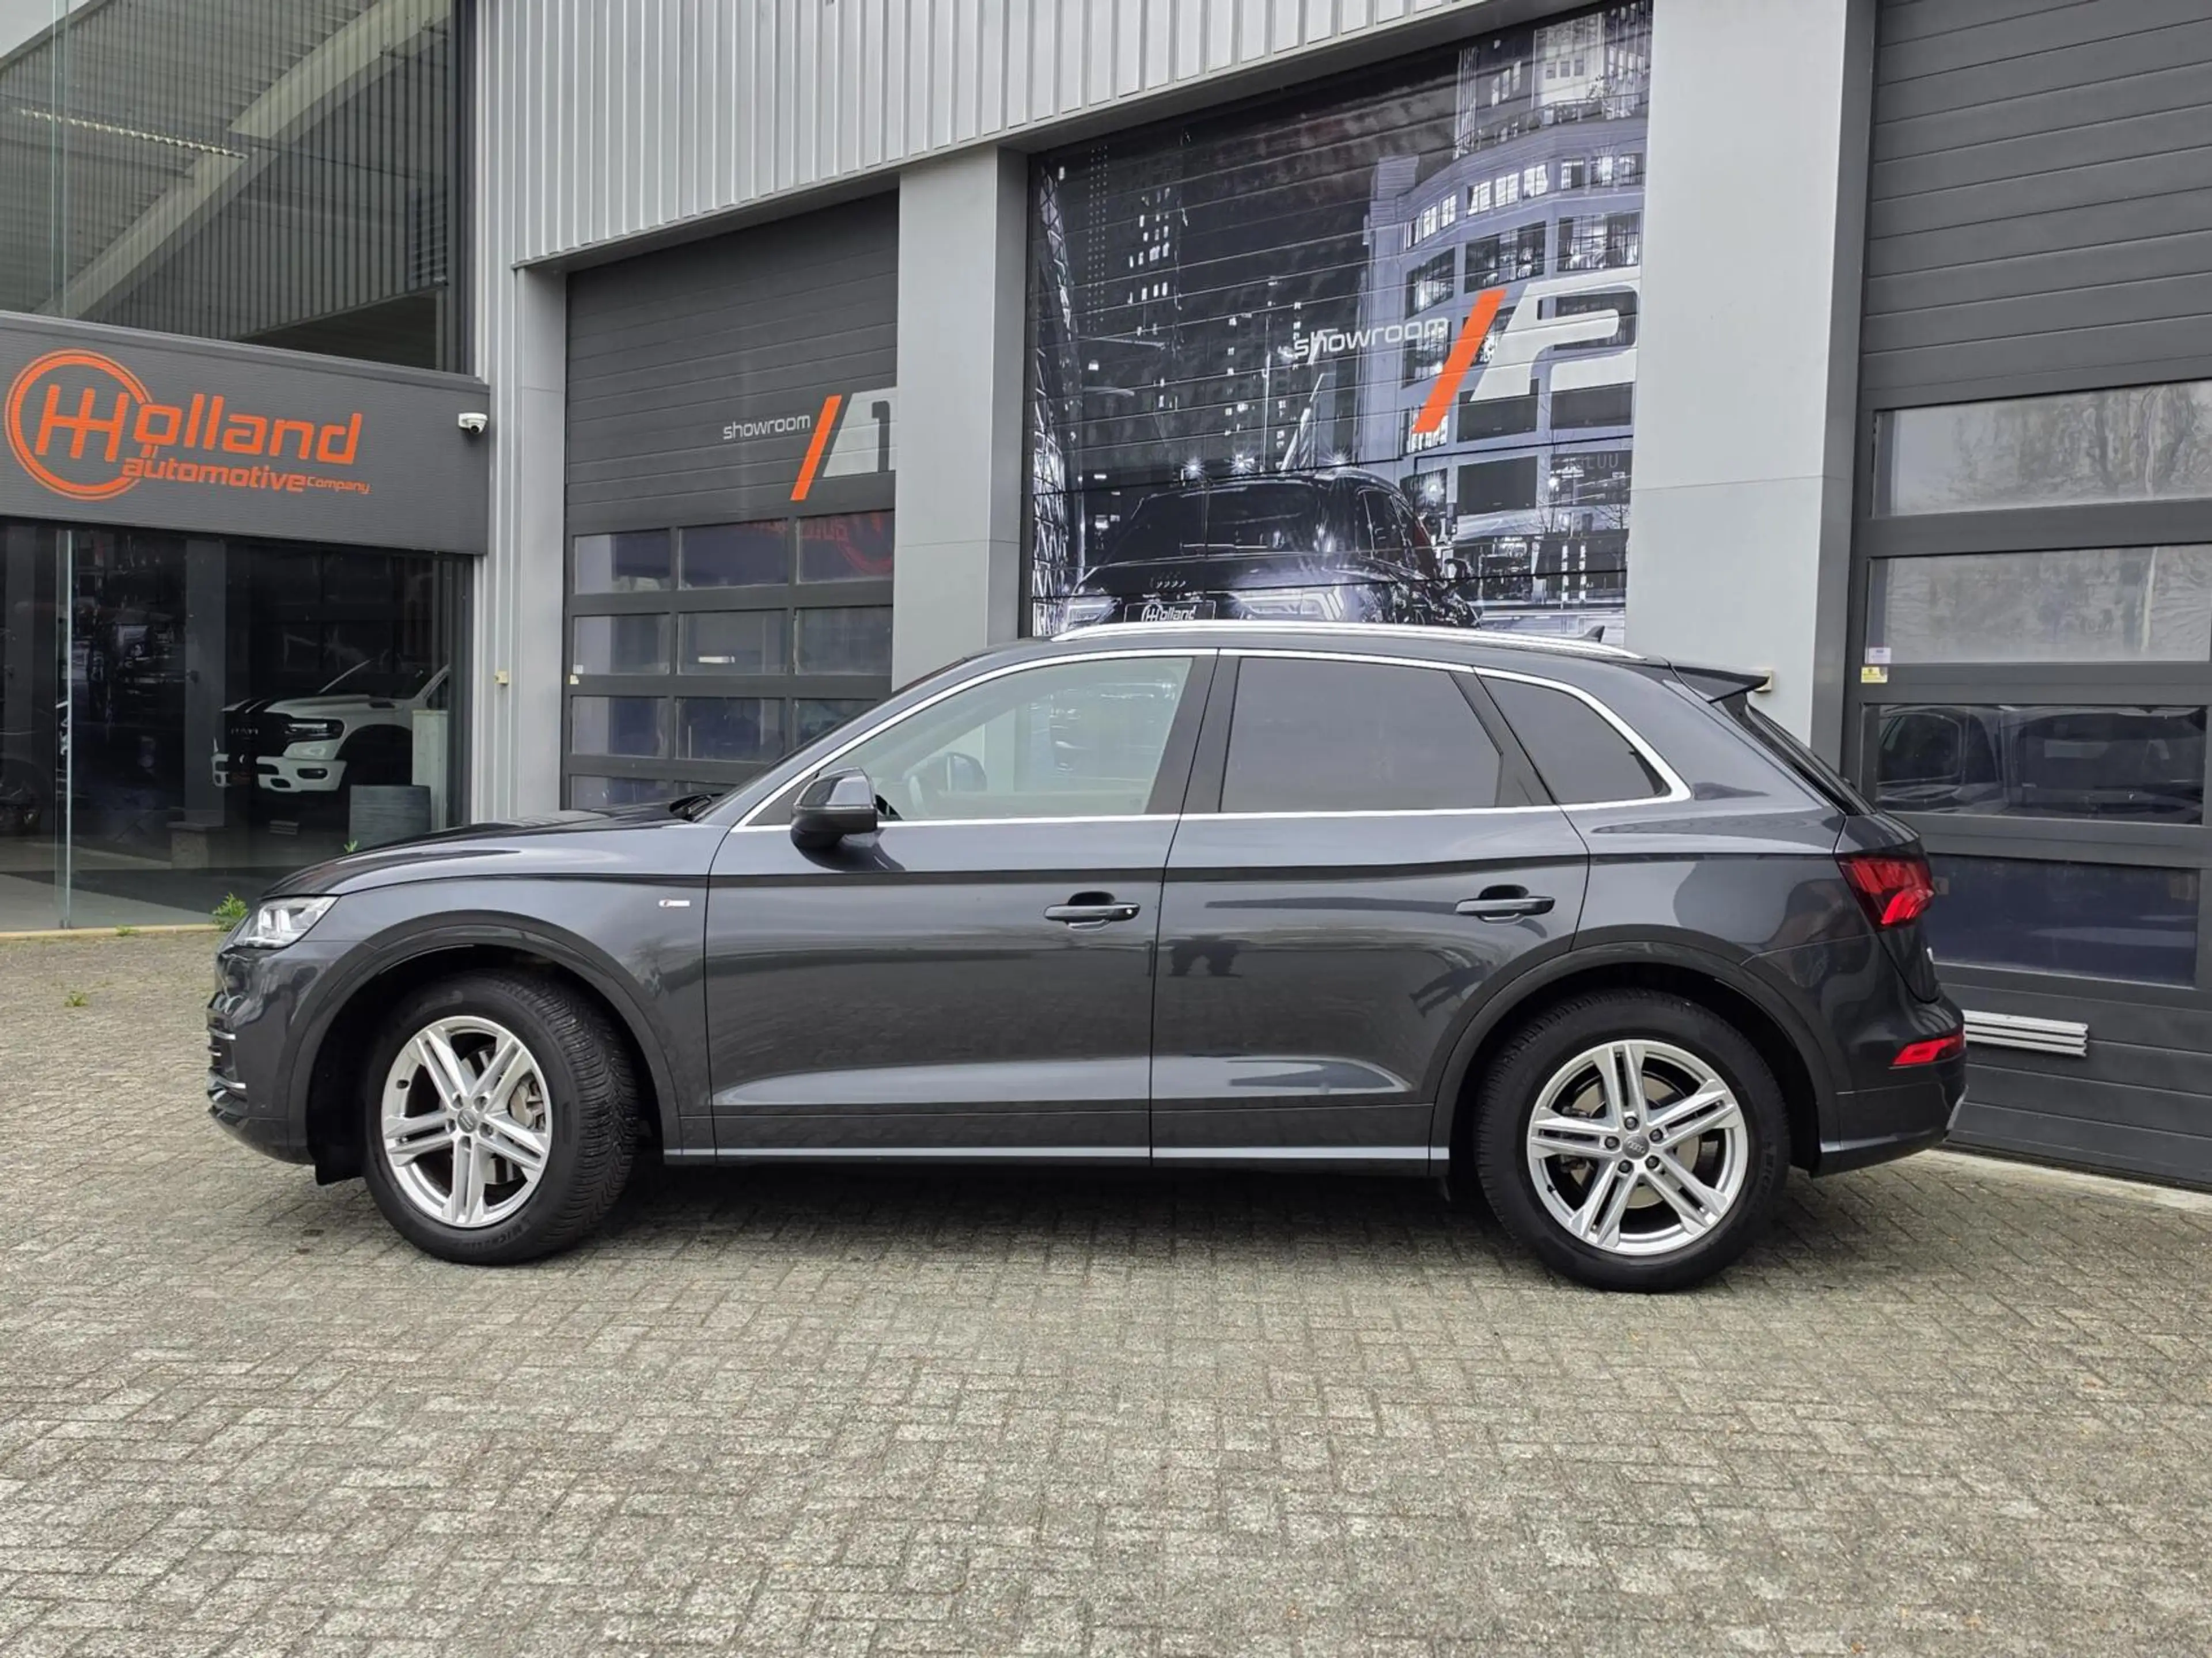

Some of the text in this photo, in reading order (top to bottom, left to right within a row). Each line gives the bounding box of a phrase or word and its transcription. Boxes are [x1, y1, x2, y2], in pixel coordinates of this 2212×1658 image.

[1294, 316, 1449, 358] showroom
[35, 382, 362, 465] Holland
[723, 414, 810, 440] showroom
[122, 458, 308, 493] automotive
